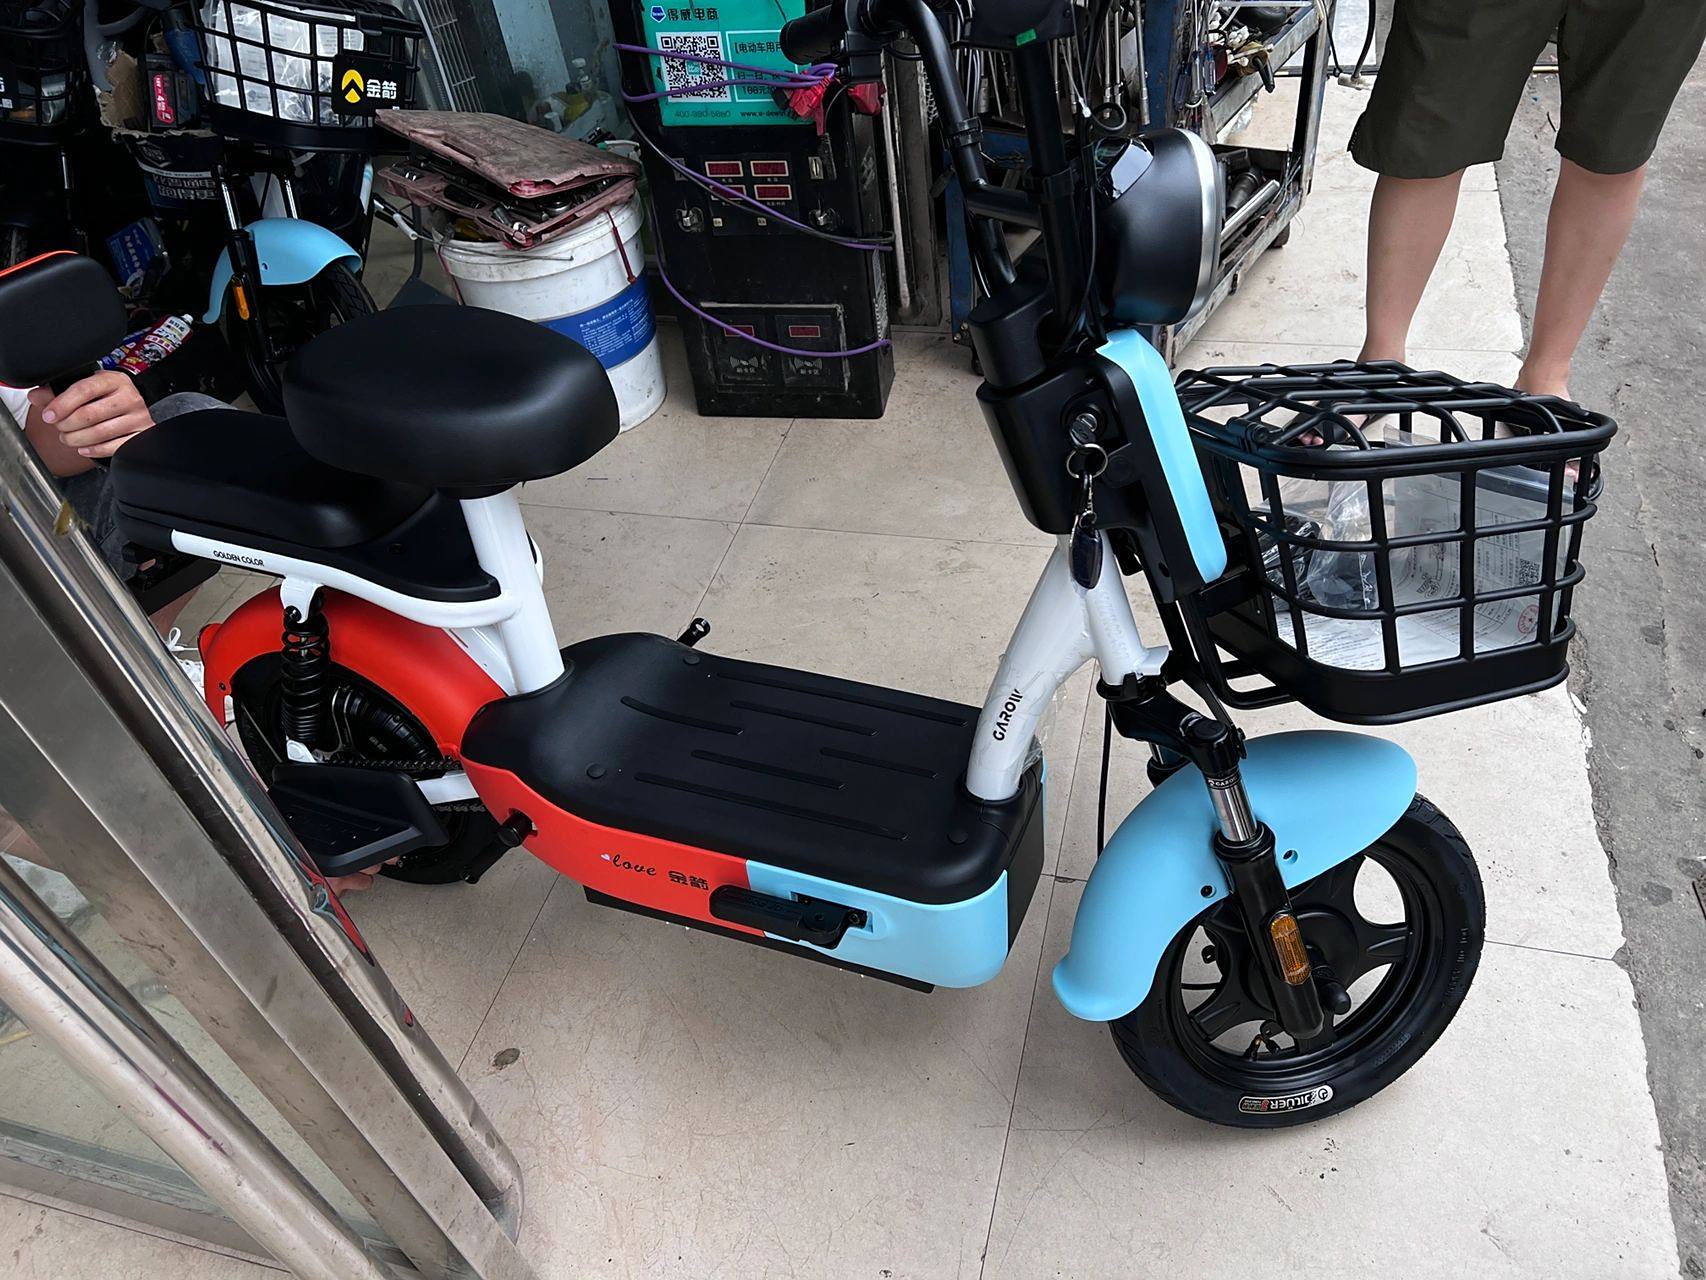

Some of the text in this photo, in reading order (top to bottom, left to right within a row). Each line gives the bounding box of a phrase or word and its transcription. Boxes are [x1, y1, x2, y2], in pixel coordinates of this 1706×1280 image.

[366, 78, 397, 100] 金箭
[213, 550, 265, 567] GOLDEN COLOR
[612, 854, 709, 891] love 金箭
